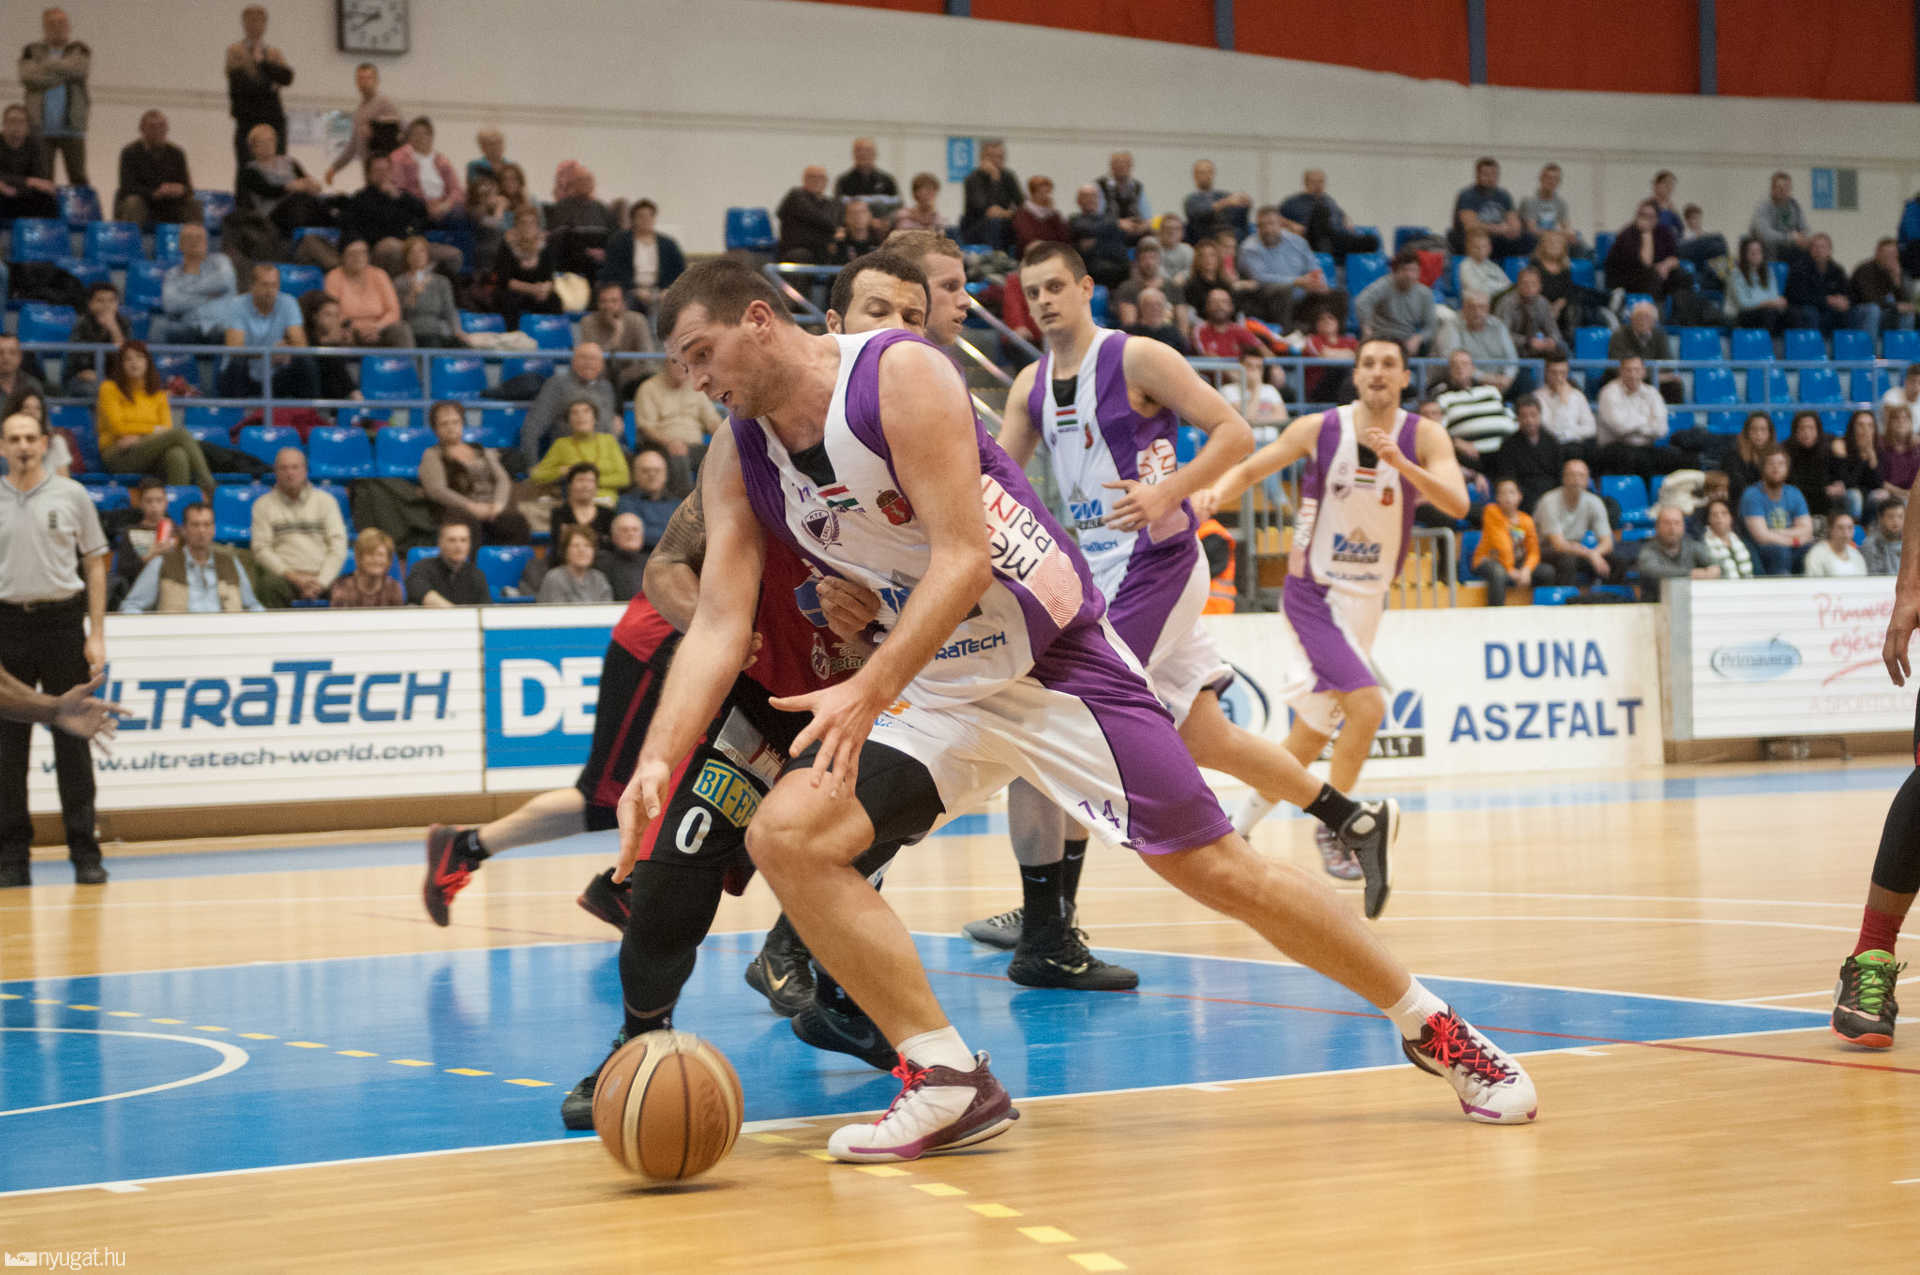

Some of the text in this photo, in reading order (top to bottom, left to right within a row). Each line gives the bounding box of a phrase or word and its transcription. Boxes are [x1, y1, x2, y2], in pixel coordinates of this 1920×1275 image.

[1484, 640, 1609, 680] DUNA
[1449, 698, 1644, 743] ASZFALT
[42, 742, 445, 773] ww.ultratech-world.com
[675, 805, 713, 855] 0
[1077, 799, 1121, 829] 14
